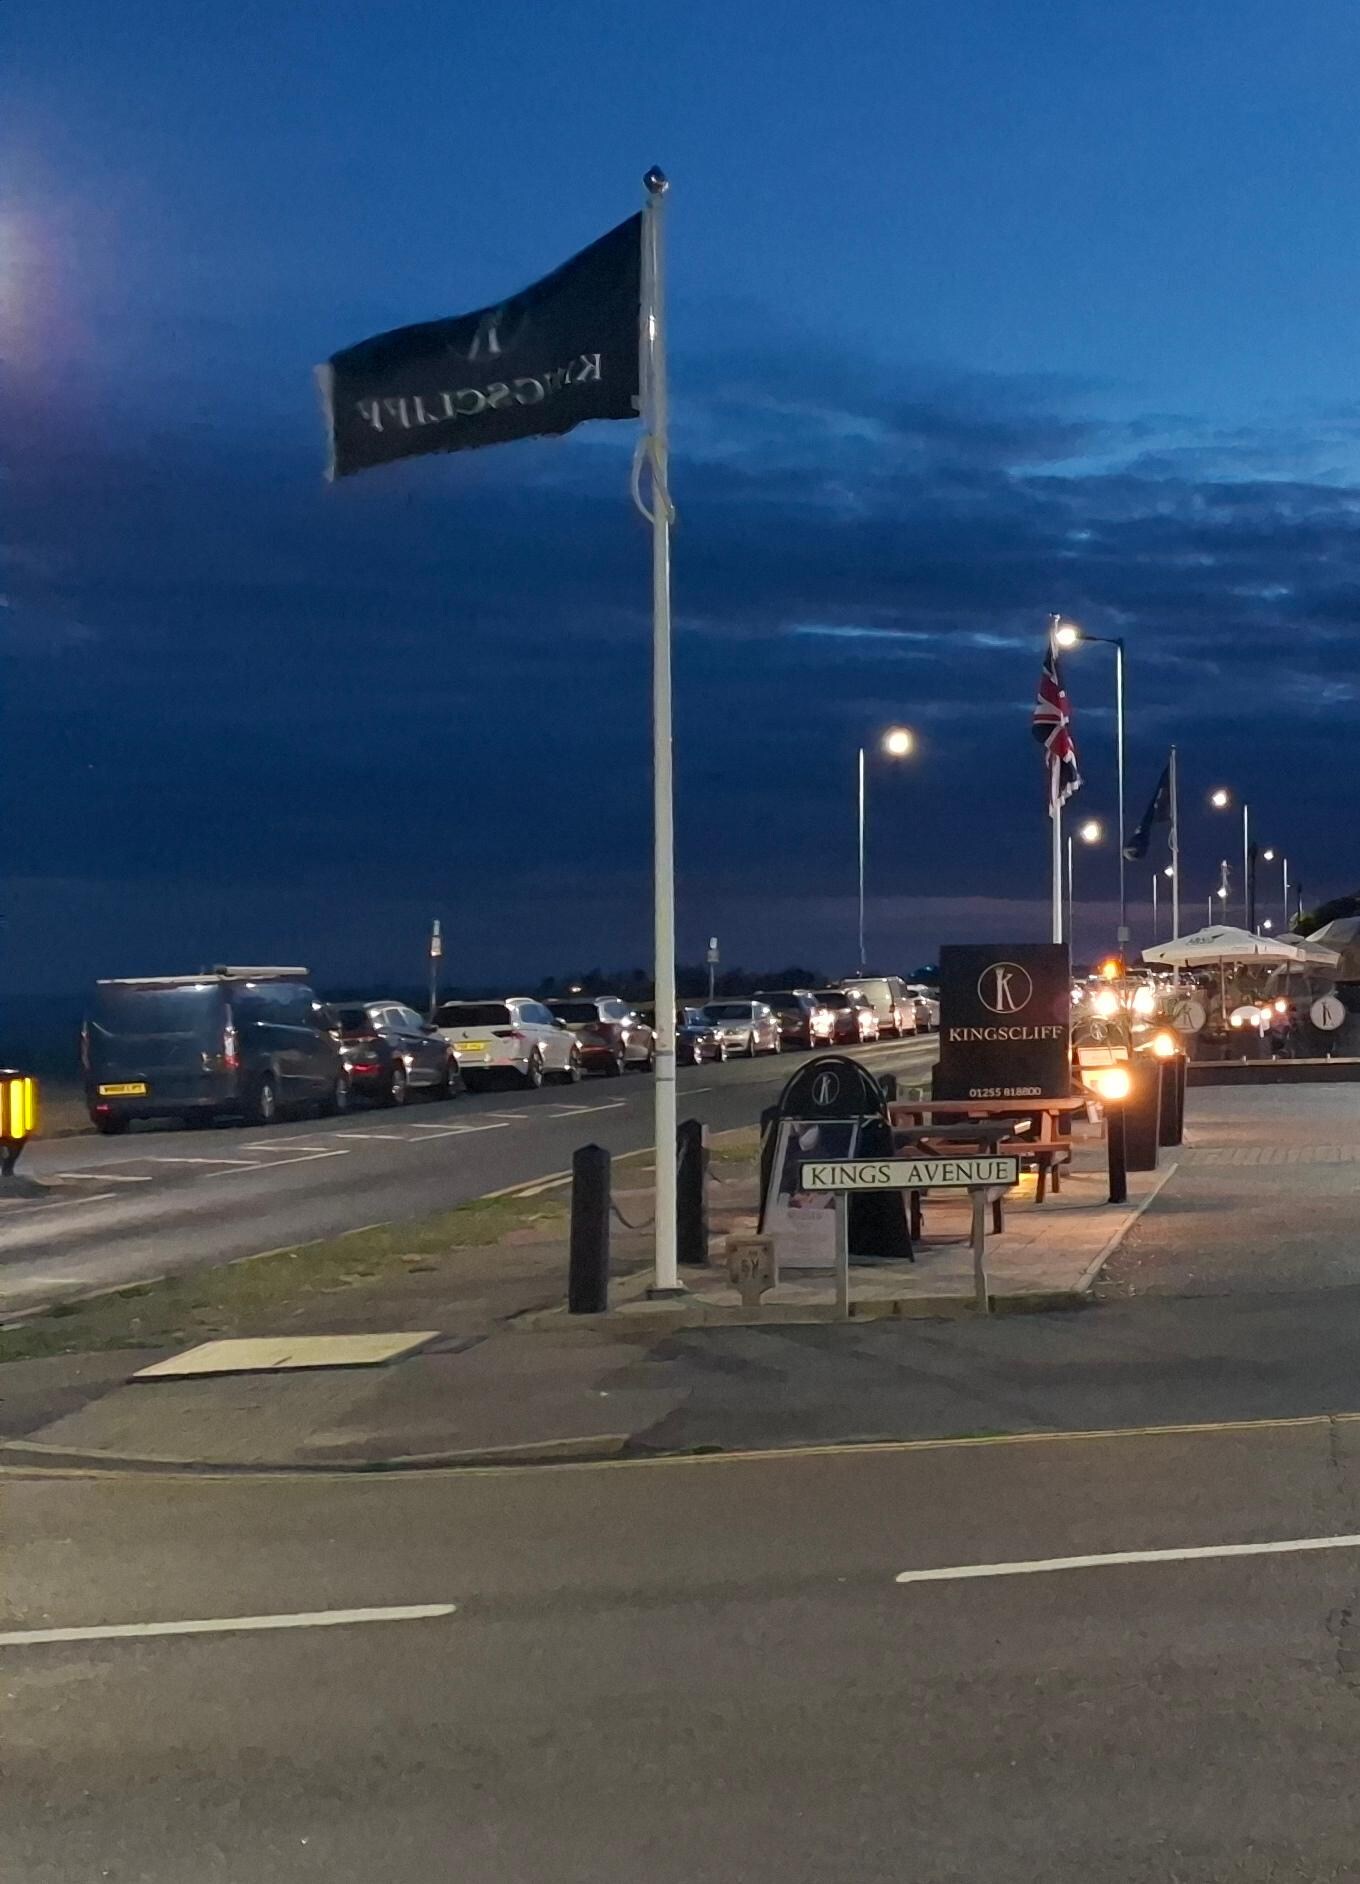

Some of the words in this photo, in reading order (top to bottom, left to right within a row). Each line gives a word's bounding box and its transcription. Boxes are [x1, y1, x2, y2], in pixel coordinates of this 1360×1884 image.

[949, 1025, 1064, 1042] KINGSCLIFF
[969, 1087, 1001, 1098] 01255
[1003, 1086, 1042, 1097] 818800
[811, 1164, 891, 1186] KINGS
[907, 1161, 1009, 1183] AVENUE
